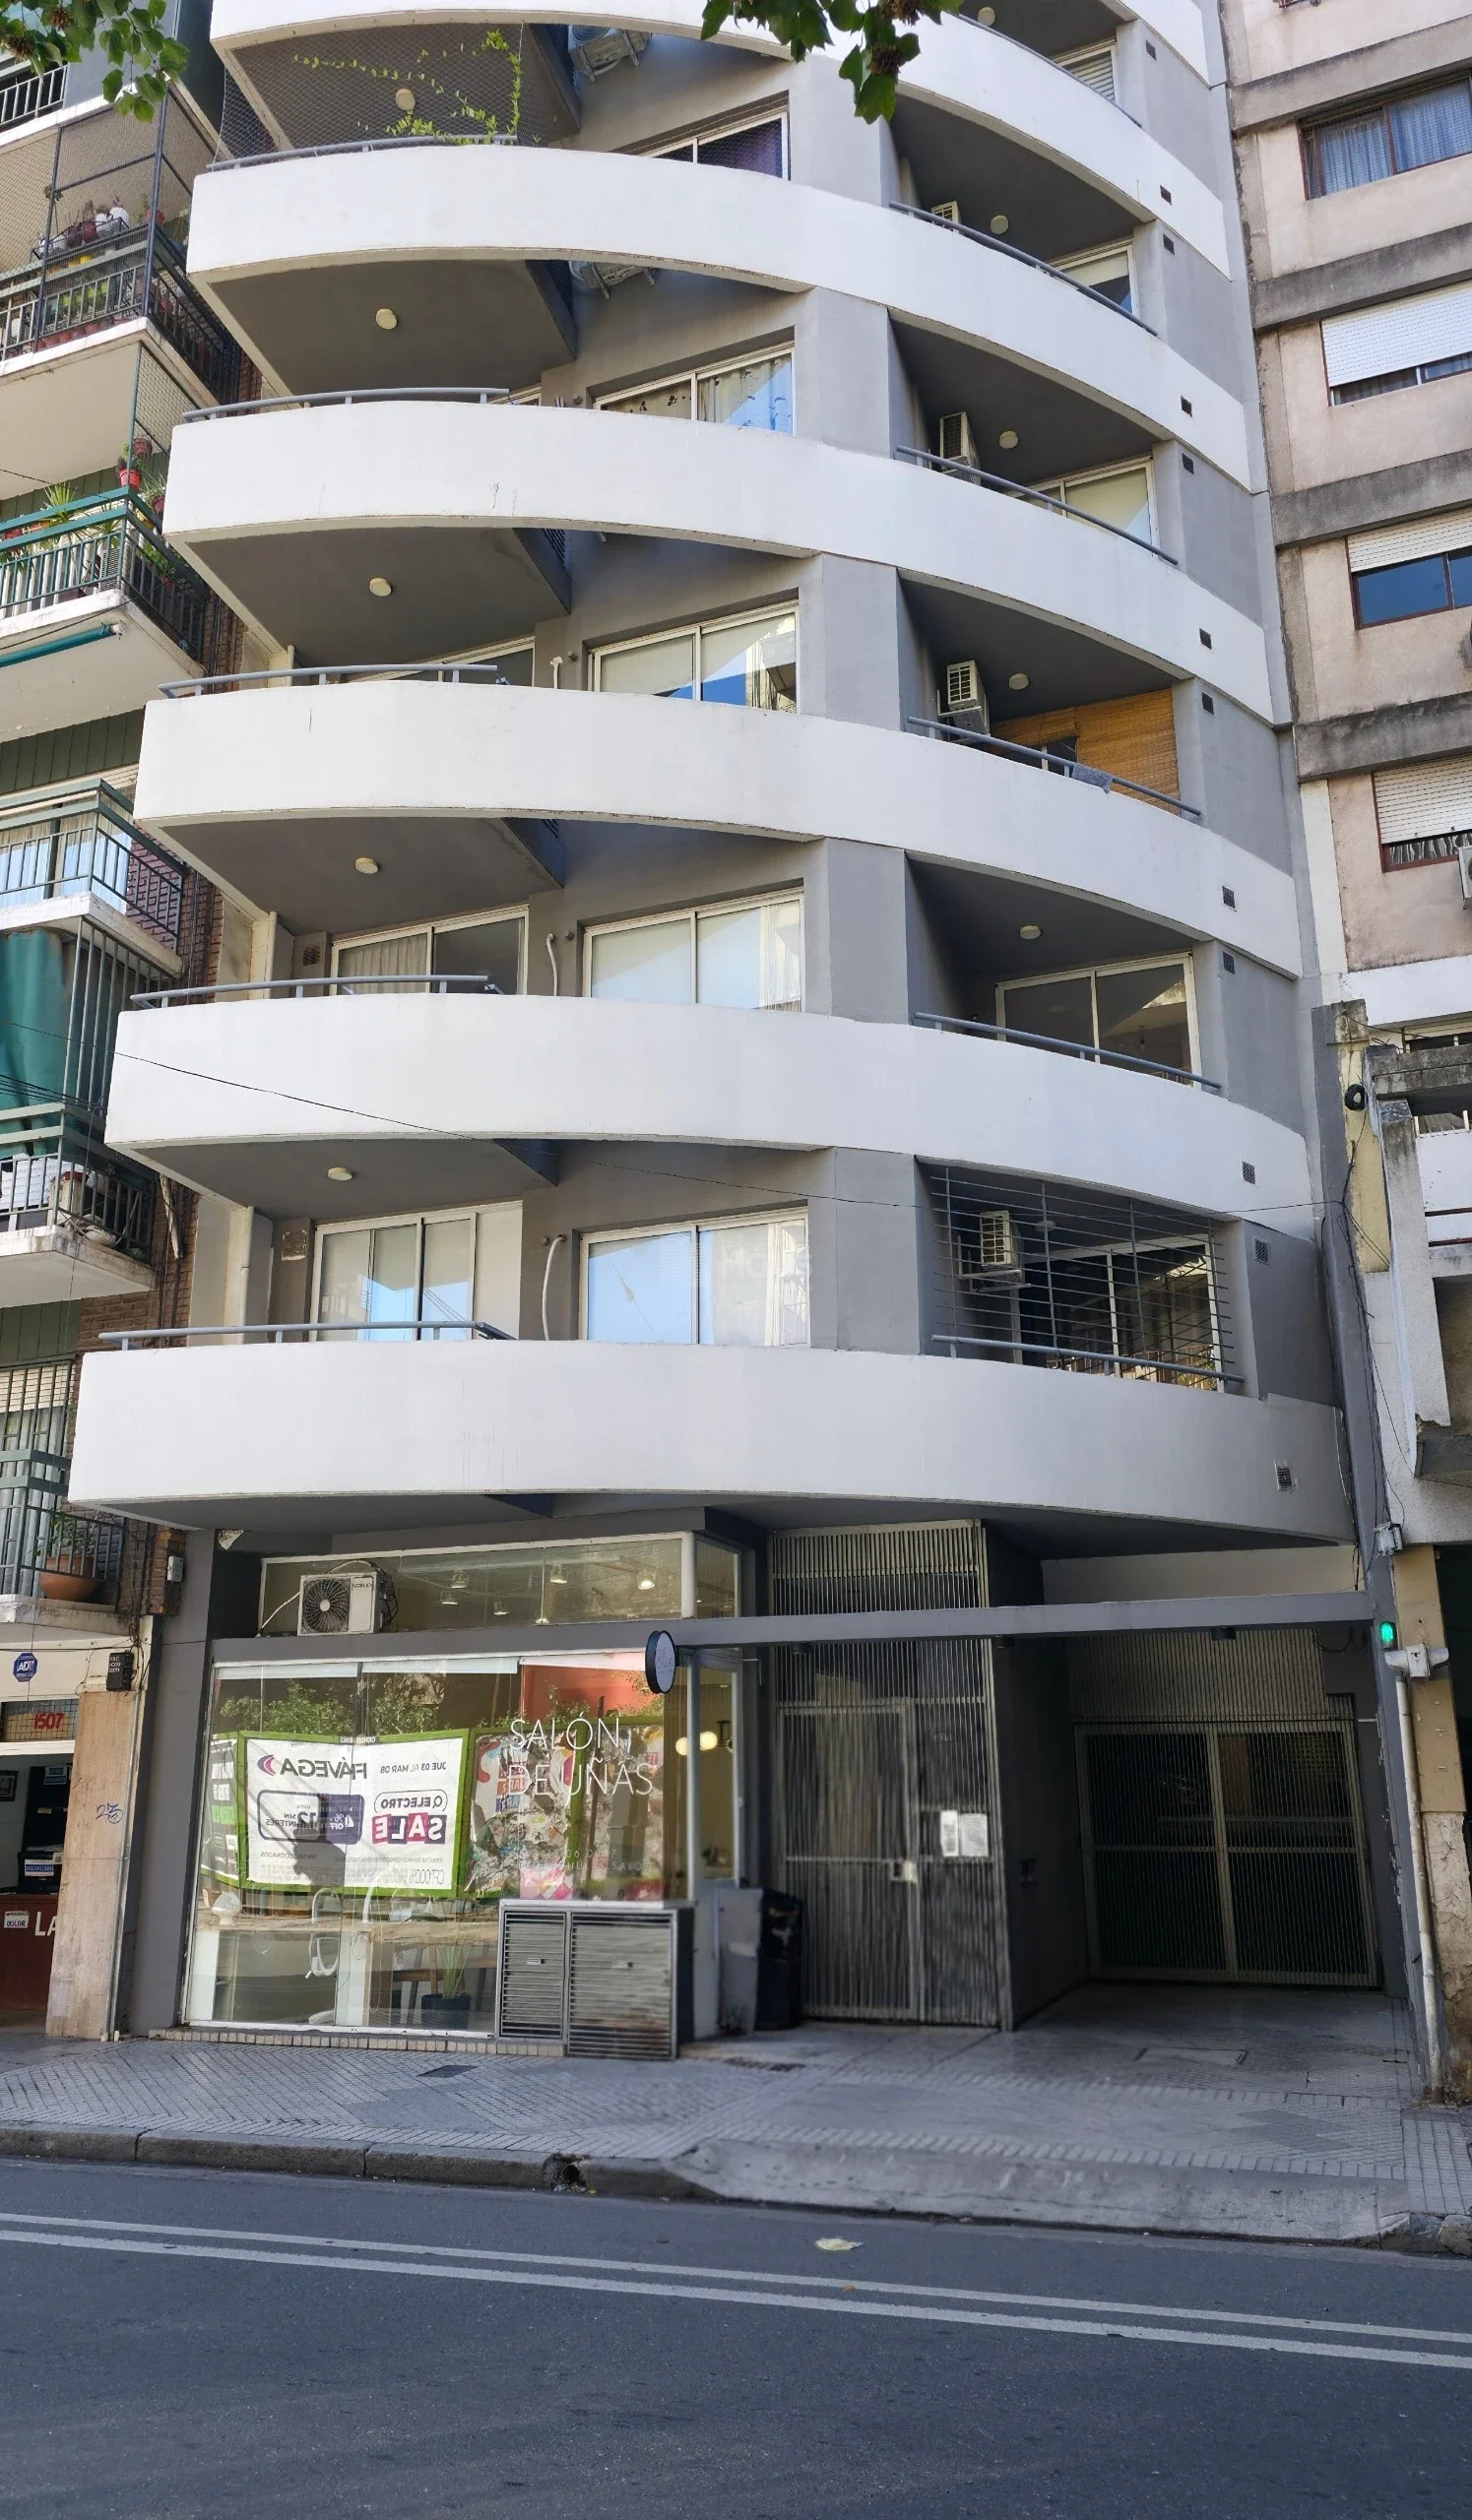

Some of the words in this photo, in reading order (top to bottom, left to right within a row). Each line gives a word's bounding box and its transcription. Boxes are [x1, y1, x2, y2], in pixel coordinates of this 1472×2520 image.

[16, 1661, 34, 1672] ADT
[33, 1713, 65, 1730] 1507
[510, 1712, 619, 1750] SALÓN
[508, 1764, 550, 1796] DE
[561, 1757, 653, 1796] UÑAS
